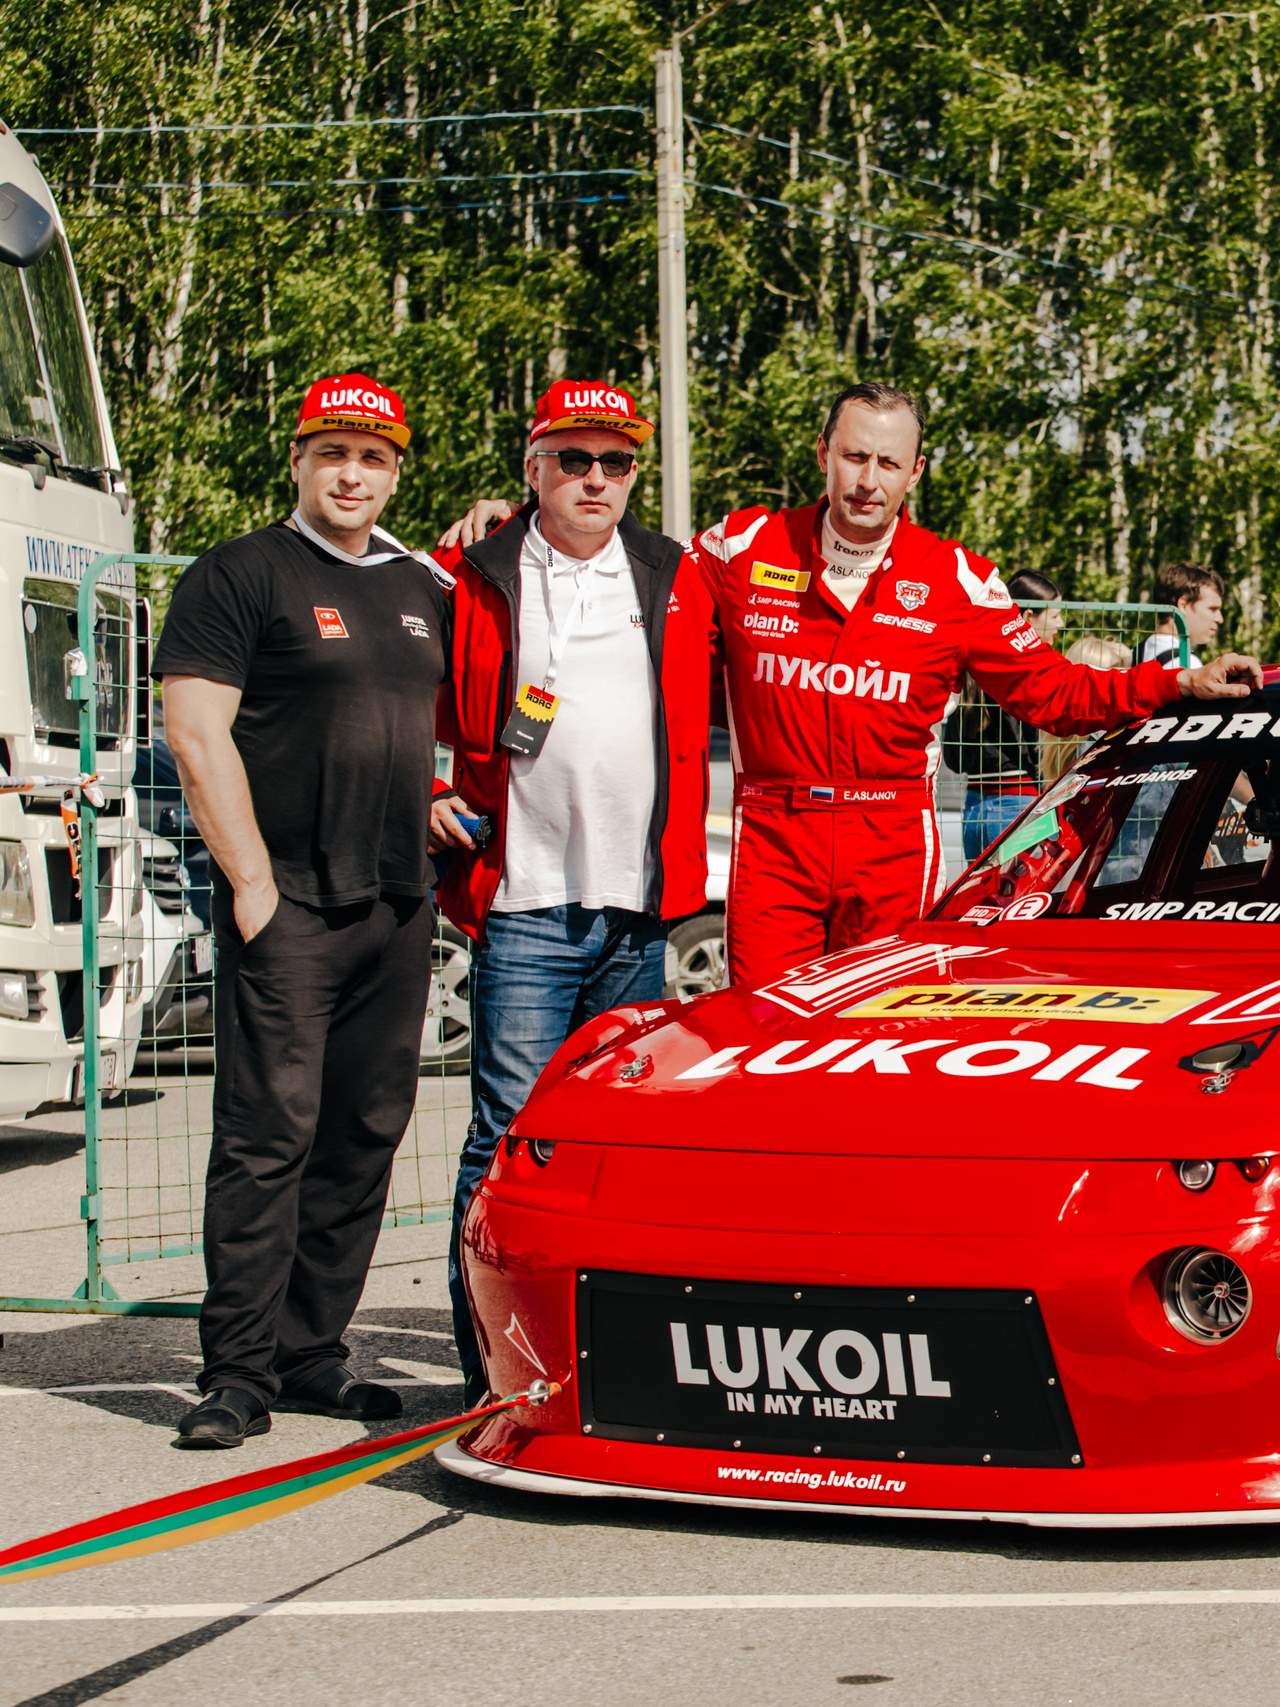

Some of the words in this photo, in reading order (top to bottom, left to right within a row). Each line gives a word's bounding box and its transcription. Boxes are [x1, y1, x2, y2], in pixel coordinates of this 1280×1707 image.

[320, 389, 395, 417] LUKOIL
[833, 540, 874, 557] freem
[763, 570, 796, 582] RDRC
[755, 596, 772, 605] SMP
[771, 598, 801, 609] RACING
[743, 612, 779, 631] plan
[780, 615, 799, 634] b:
[872, 613, 936, 634] GENESIS
[753, 652, 911, 703] ЛУКОЙЛ
[525, 693, 552, 710] RDRC
[1105, 769, 1197, 788] АСЛАНОВ
[843, 790, 897, 801] E.ASLANOV
[1013, 900, 1038, 918] E
[1099, 901, 1184, 921] SMP
[881, 989, 1077, 1011] plan
[1077, 991, 1161, 1011] b:
[673, 1039, 1151, 1091] LUKOIL
[670, 1322, 951, 1397] LUKOIL
[727, 1392, 755, 1412] IN
[764, 1394, 803, 1415] MY
[813, 1397, 897, 1420] HEART
[717, 1467, 906, 1492] www.racing.lukoil.ru
